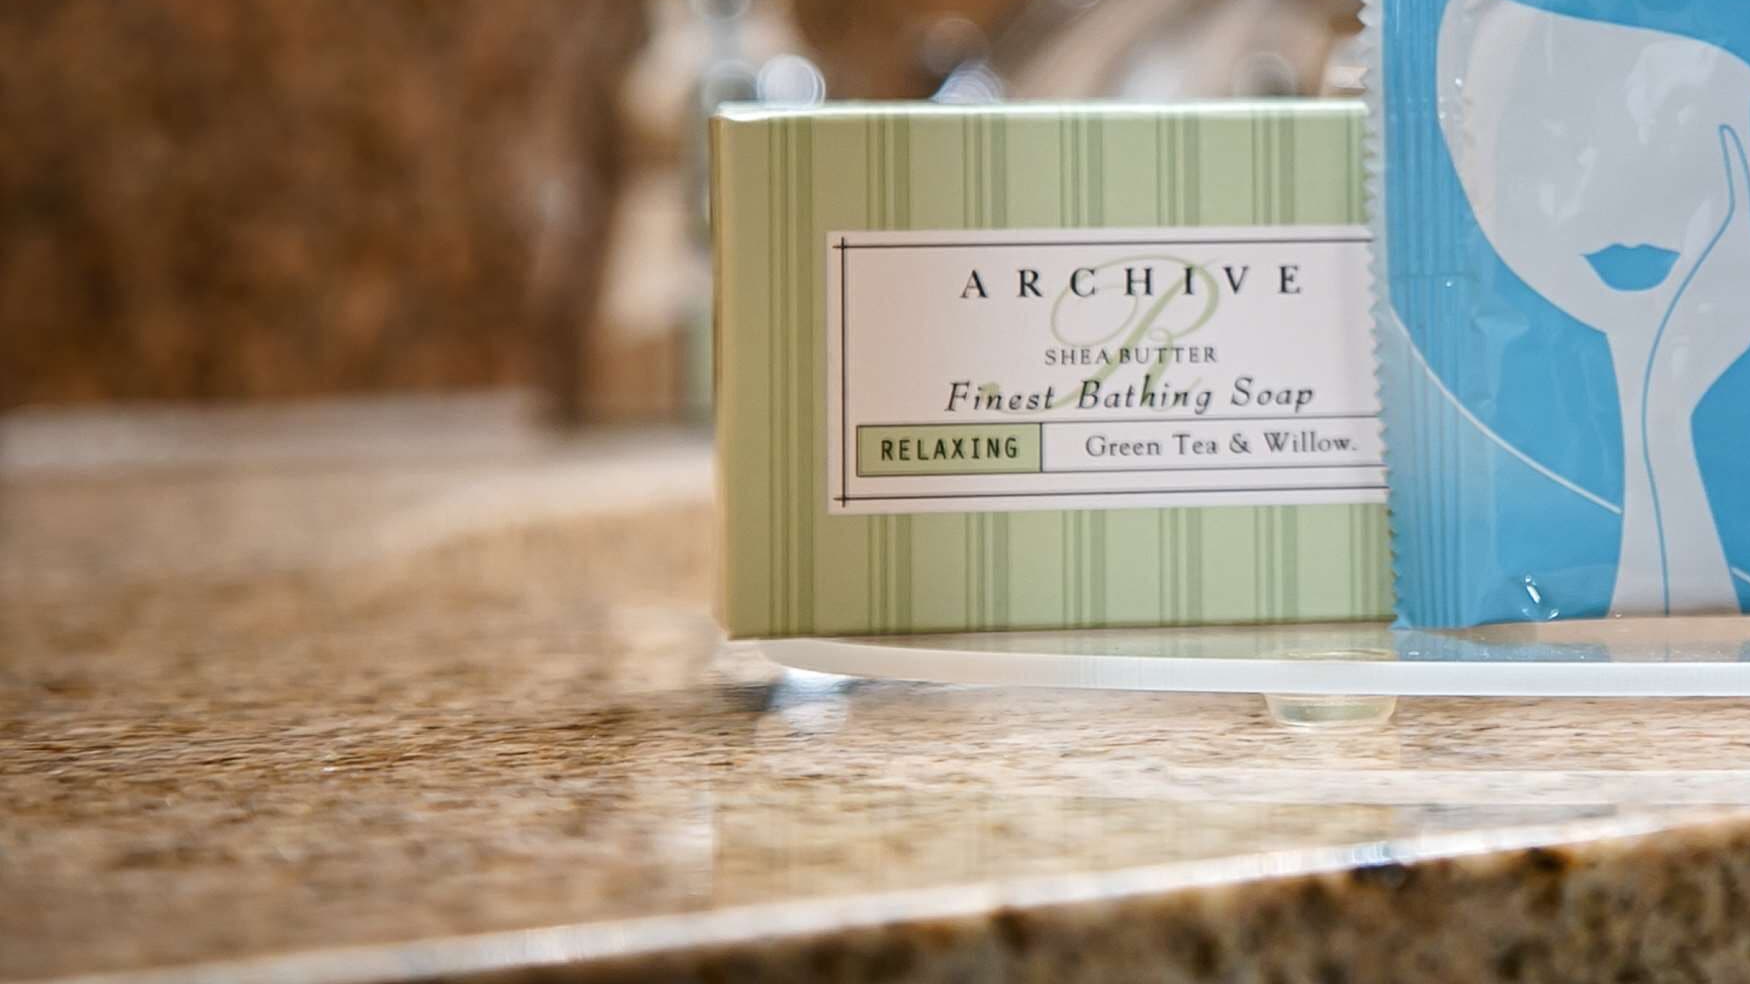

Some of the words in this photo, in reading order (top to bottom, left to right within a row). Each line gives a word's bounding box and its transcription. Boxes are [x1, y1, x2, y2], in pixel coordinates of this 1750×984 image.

[960, 264, 1303, 299] ARCHIVE
[945, 381, 1056, 413] Finest
[1077, 374, 1213, 415] Bathing
[1230, 376, 1316, 412] Soap
[881, 438, 1020, 462] RELAXING
[1085, 435, 1161, 457] Green
[1173, 433, 1218, 456] Tea
[1229, 434, 1251, 455] &
[1263, 430, 1358, 454] Willow.
